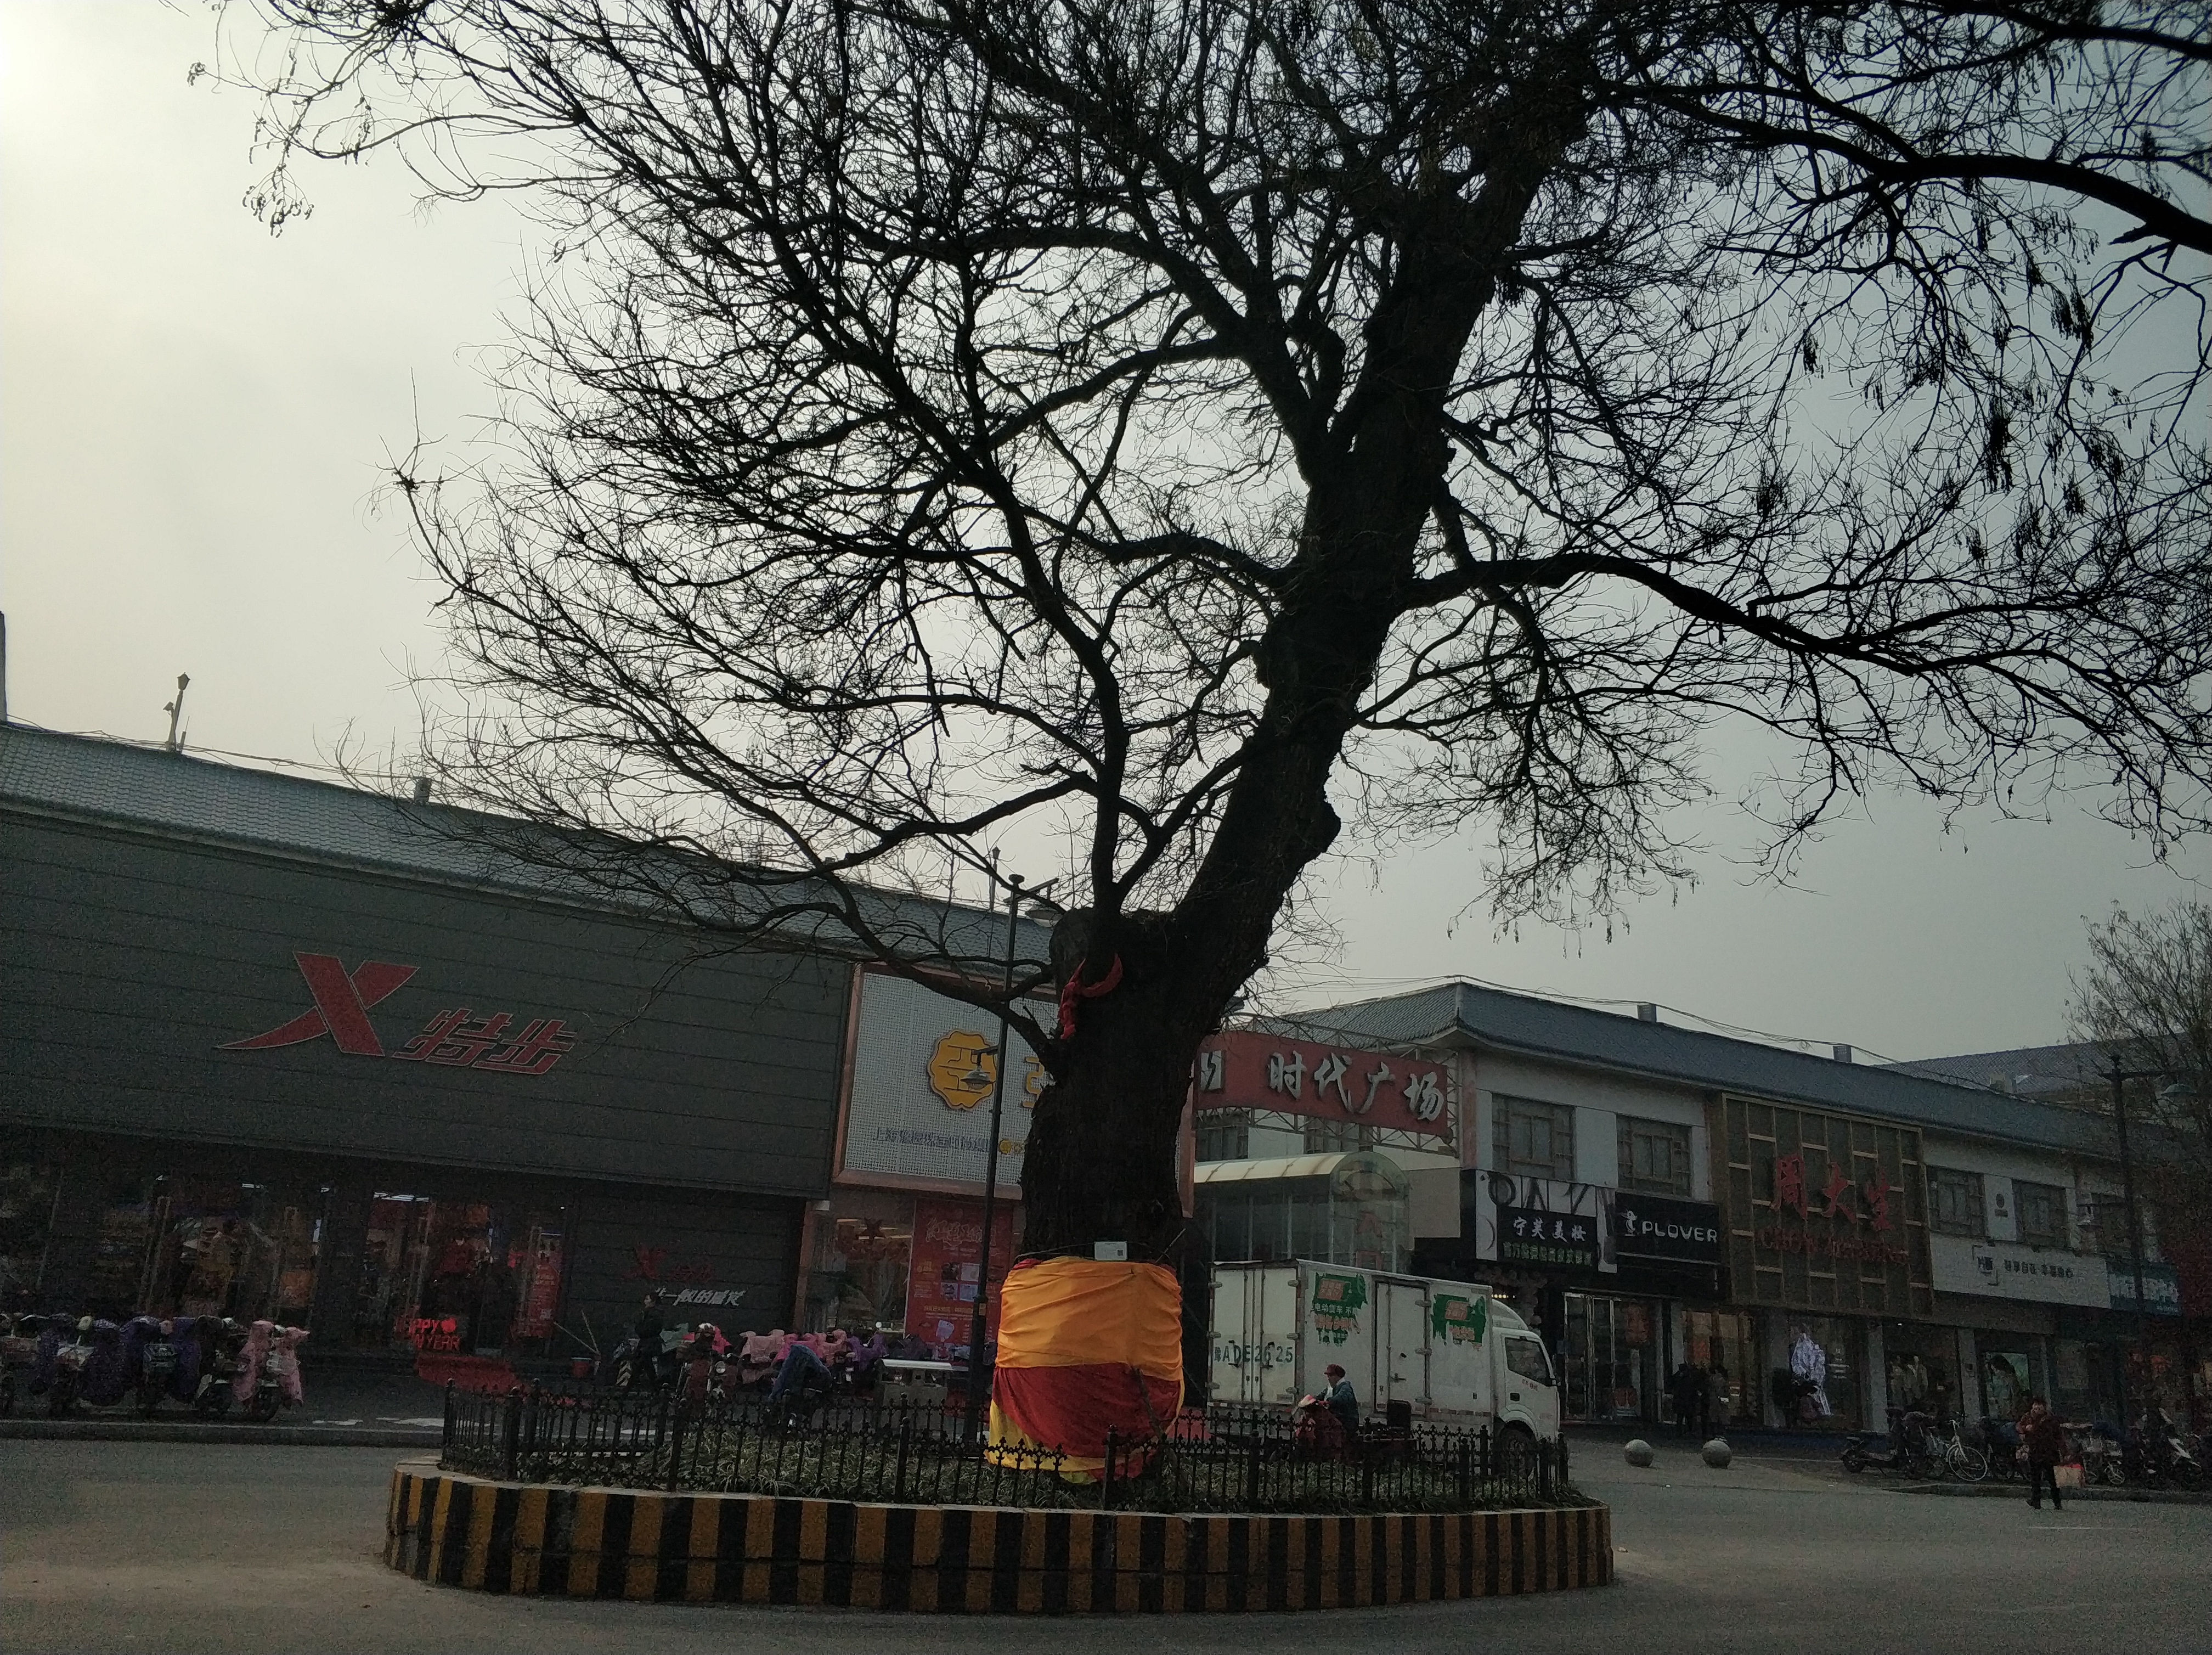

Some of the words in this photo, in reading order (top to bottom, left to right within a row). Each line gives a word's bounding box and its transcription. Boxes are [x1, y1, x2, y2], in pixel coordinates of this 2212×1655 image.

[391, 1007, 578, 1075] 特步
[1268, 1050, 1446, 1121] 时代广场
[873, 1126, 989, 1153] 上海豫园珠宝时尚集
[1769, 1155, 1896, 1232] 周大生
[1641, 1220, 1718, 1243] PLOVER
